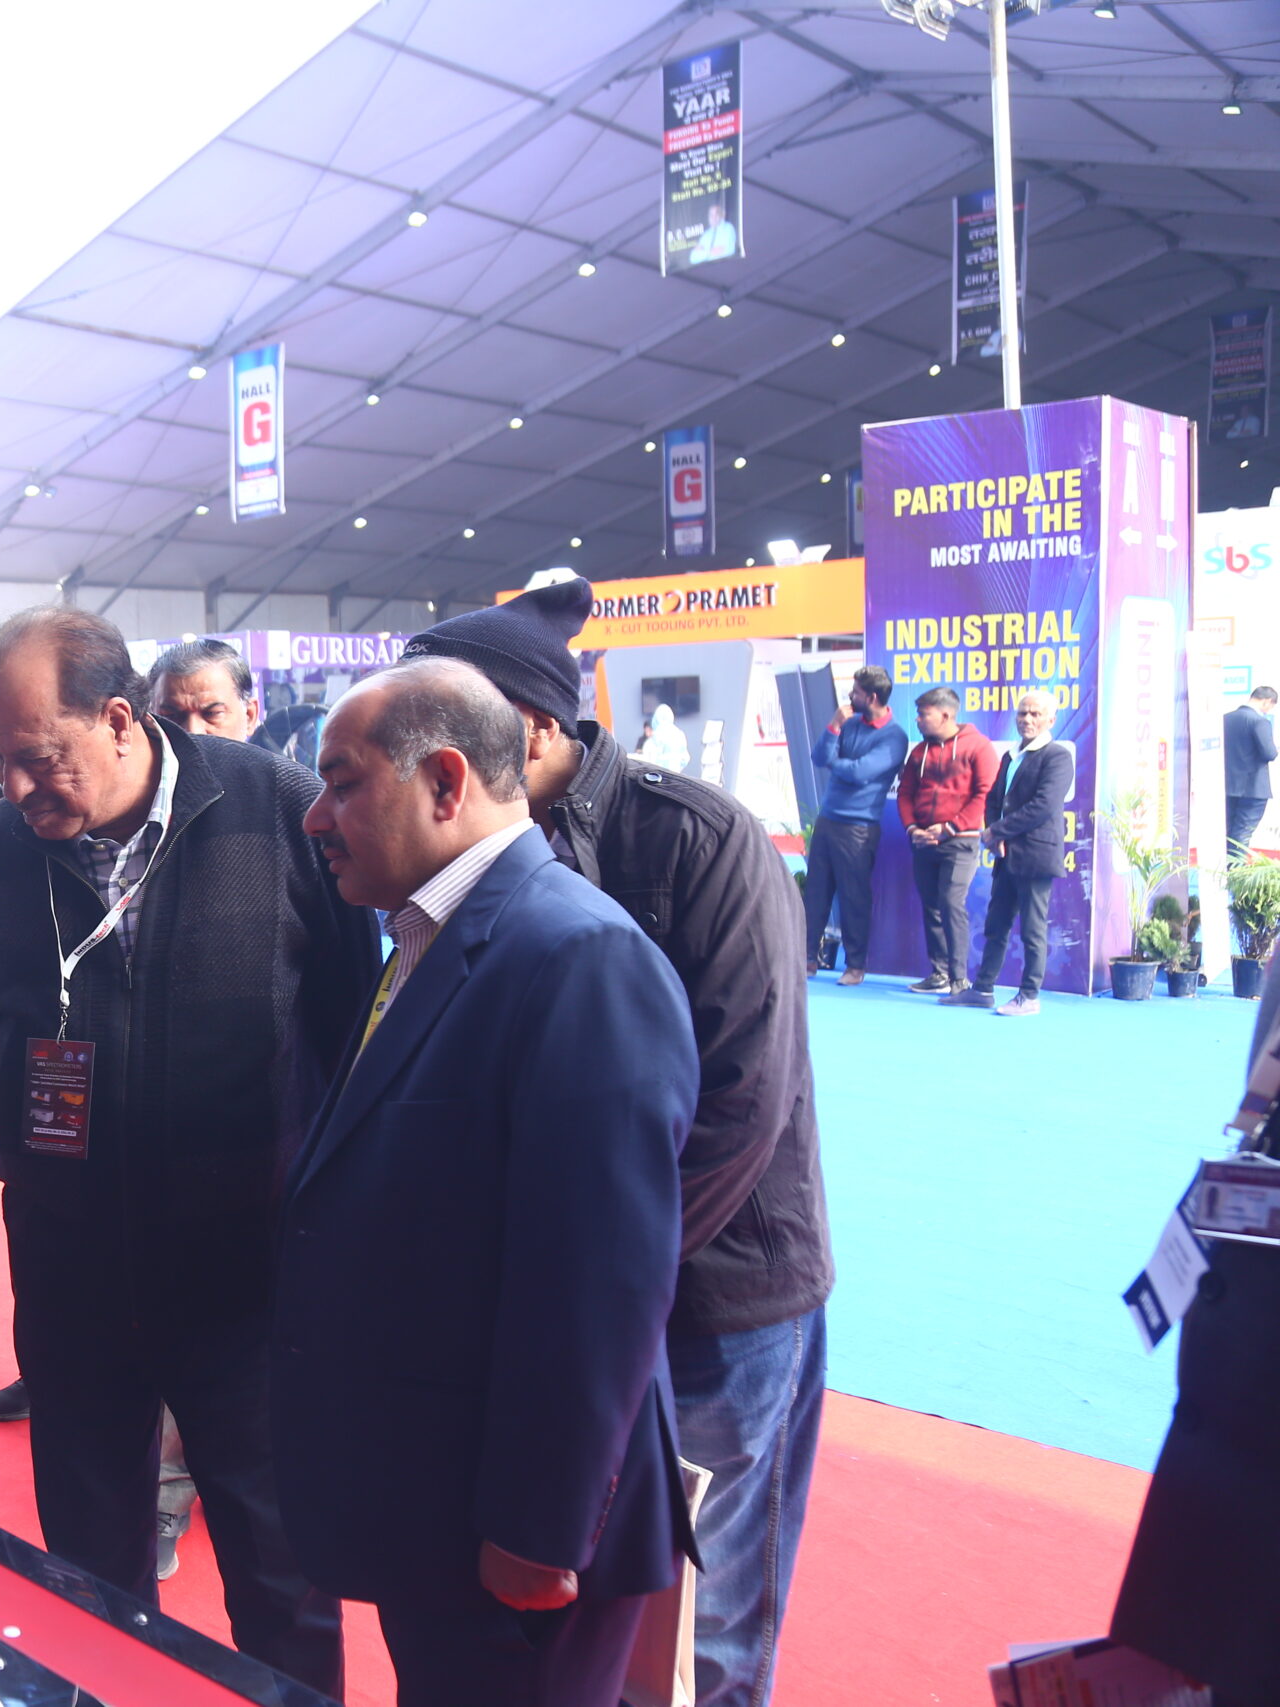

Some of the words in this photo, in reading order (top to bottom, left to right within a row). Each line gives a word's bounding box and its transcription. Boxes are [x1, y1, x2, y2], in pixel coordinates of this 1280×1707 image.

[672, 87, 731, 119] YAAR
[241, 382, 272, 400] HALL
[243, 401, 272, 447] G
[672, 453, 703, 467] HALL
[674, 468, 702, 504] G
[893, 468, 1082, 517] PARTICIPATE
[982, 509, 1012, 539] IN
[1022, 500, 1082, 534] THE
[930, 543, 982, 568] MOST
[988, 534, 1082, 564] AWAITING
[591, 592, 660, 618] ORMER
[687, 583, 778, 612] PRAMET
[621, 623, 642, 634] CUT
[645, 618, 696, 633] TOOLING
[885, 609, 1081, 651] INDUSTRIAL
[291, 635, 408, 666] GURUSAR
[893, 646, 1081, 685] EXHIBITION
[964, 684, 1080, 713] BHIWDI
[73, 922, 110, 957] INDUS-tech
